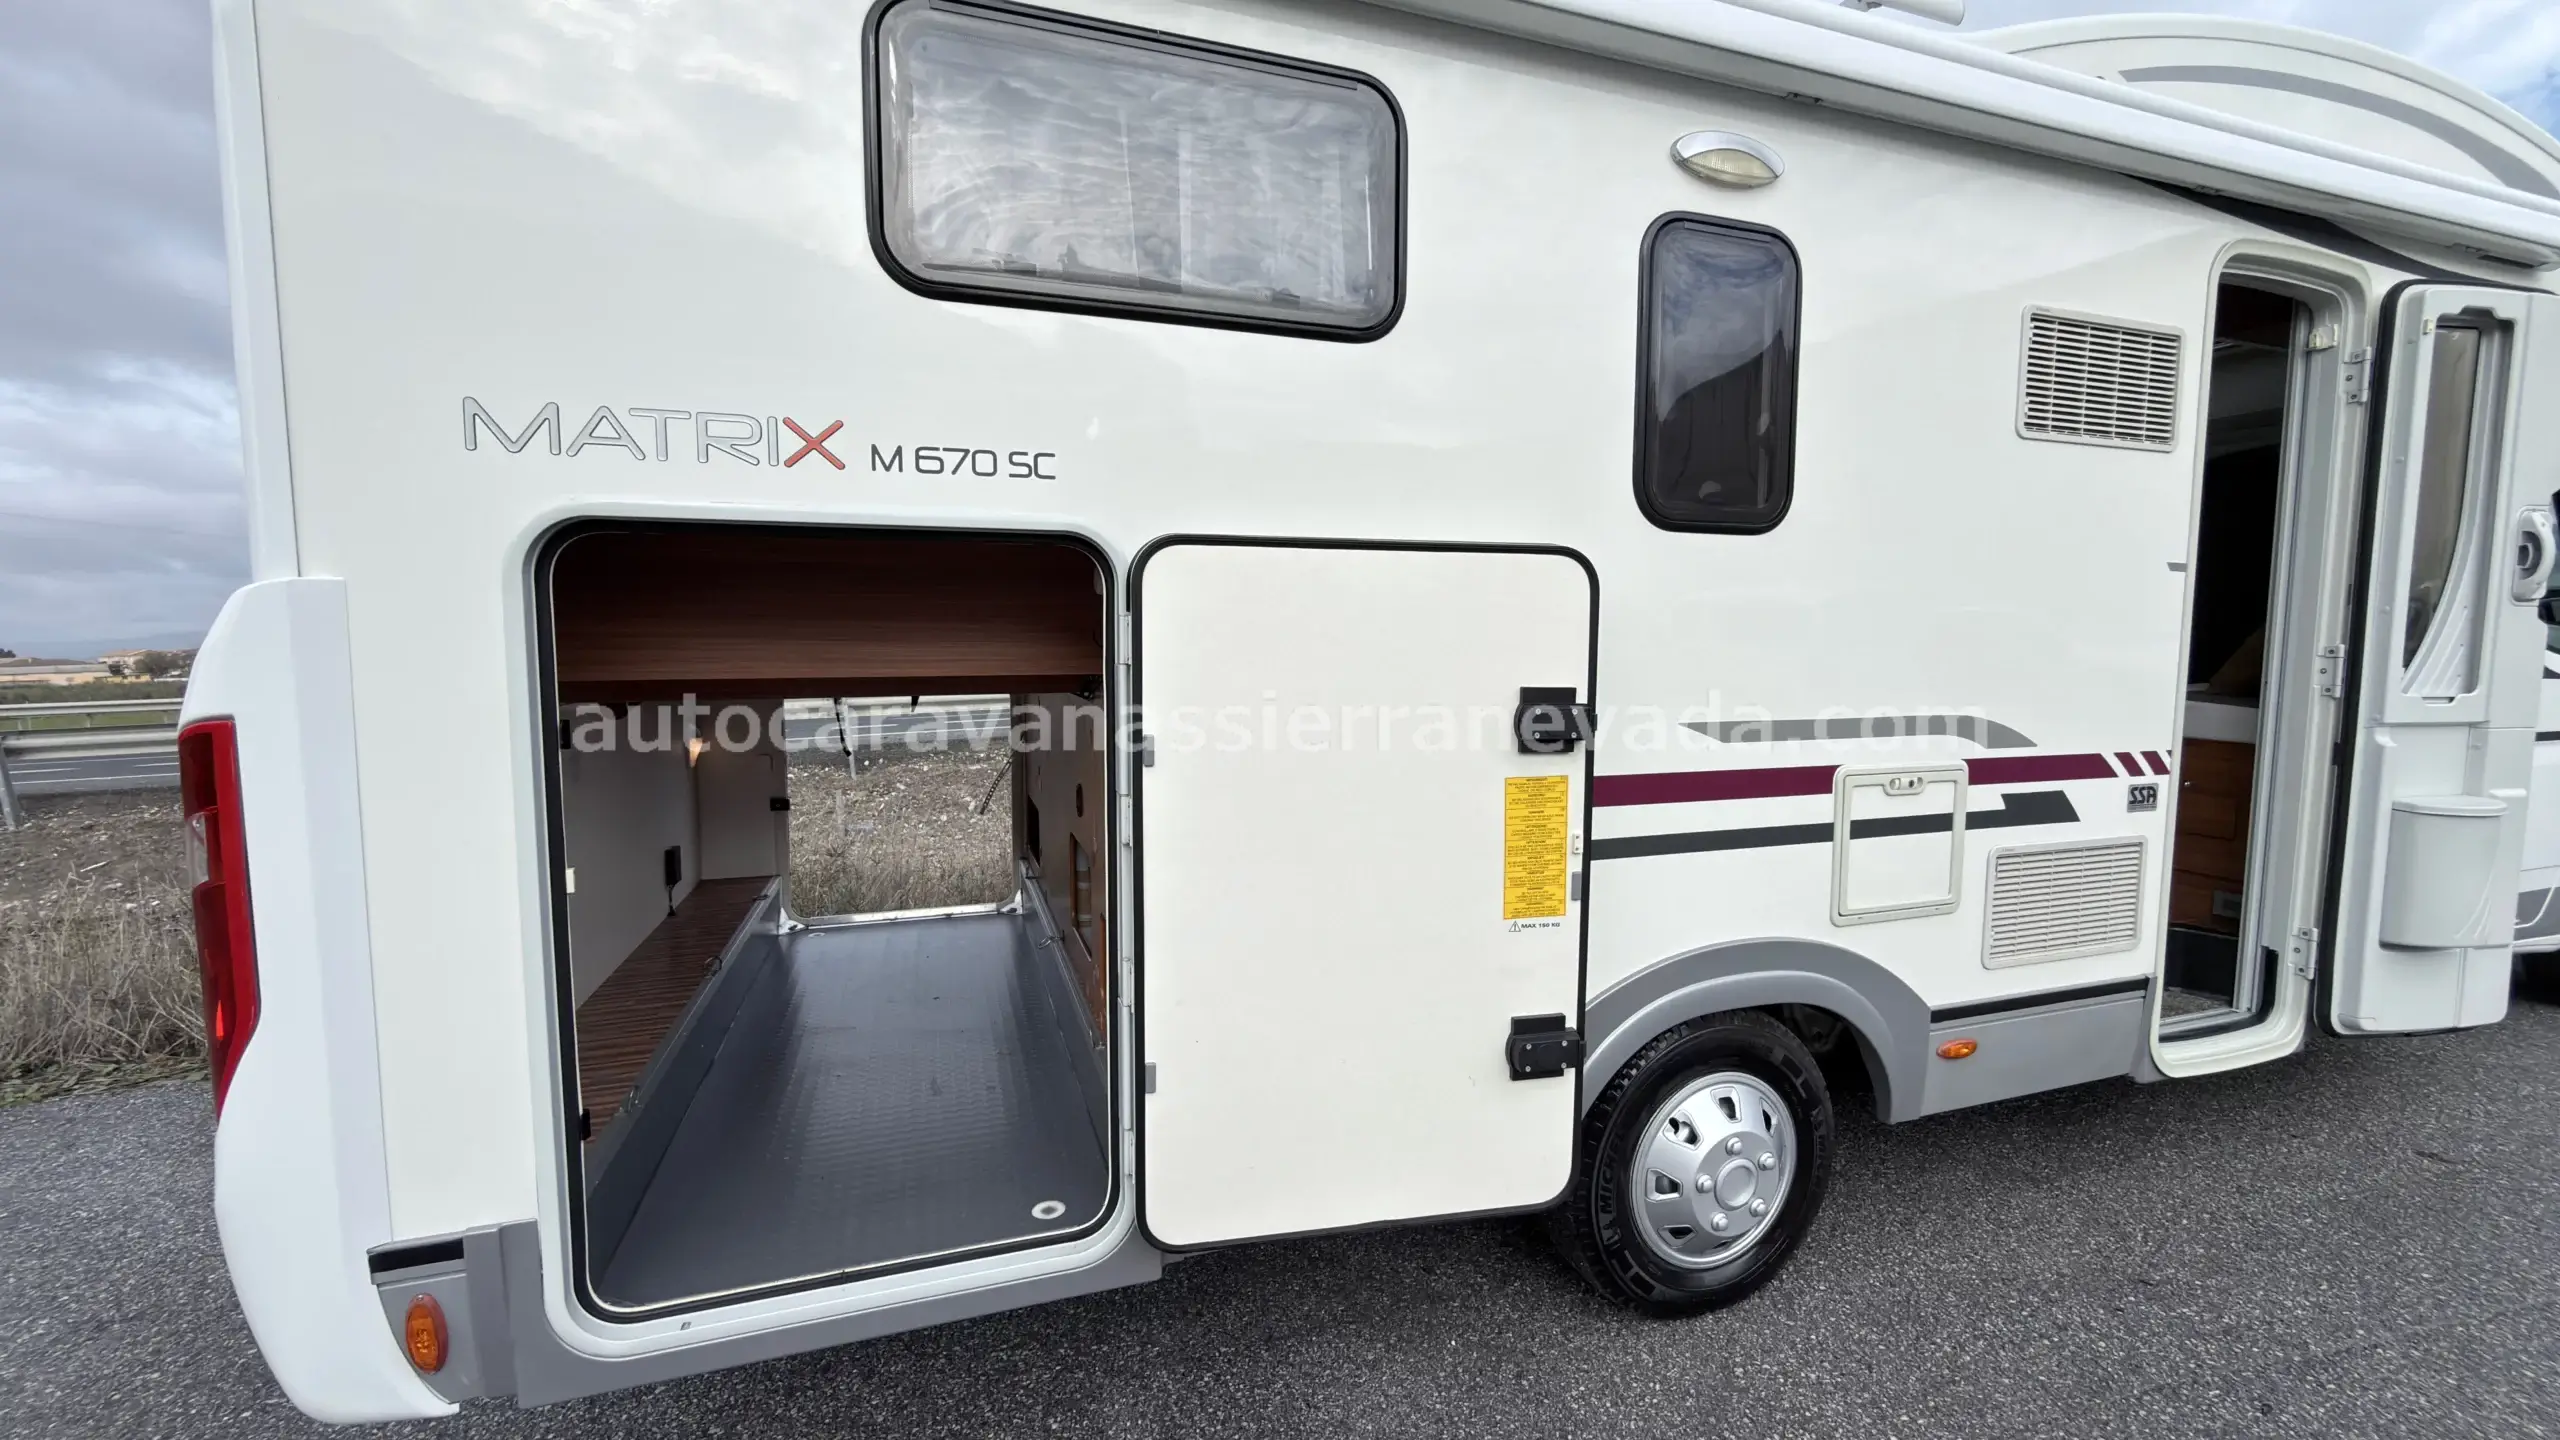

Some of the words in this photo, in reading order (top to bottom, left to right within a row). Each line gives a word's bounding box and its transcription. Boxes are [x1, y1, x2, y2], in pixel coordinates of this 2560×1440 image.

[462, 396, 846, 471] MATRIX
[870, 443, 904, 474] M
[913, 446, 998, 479] 670
[1008, 450, 1057, 481] SC
